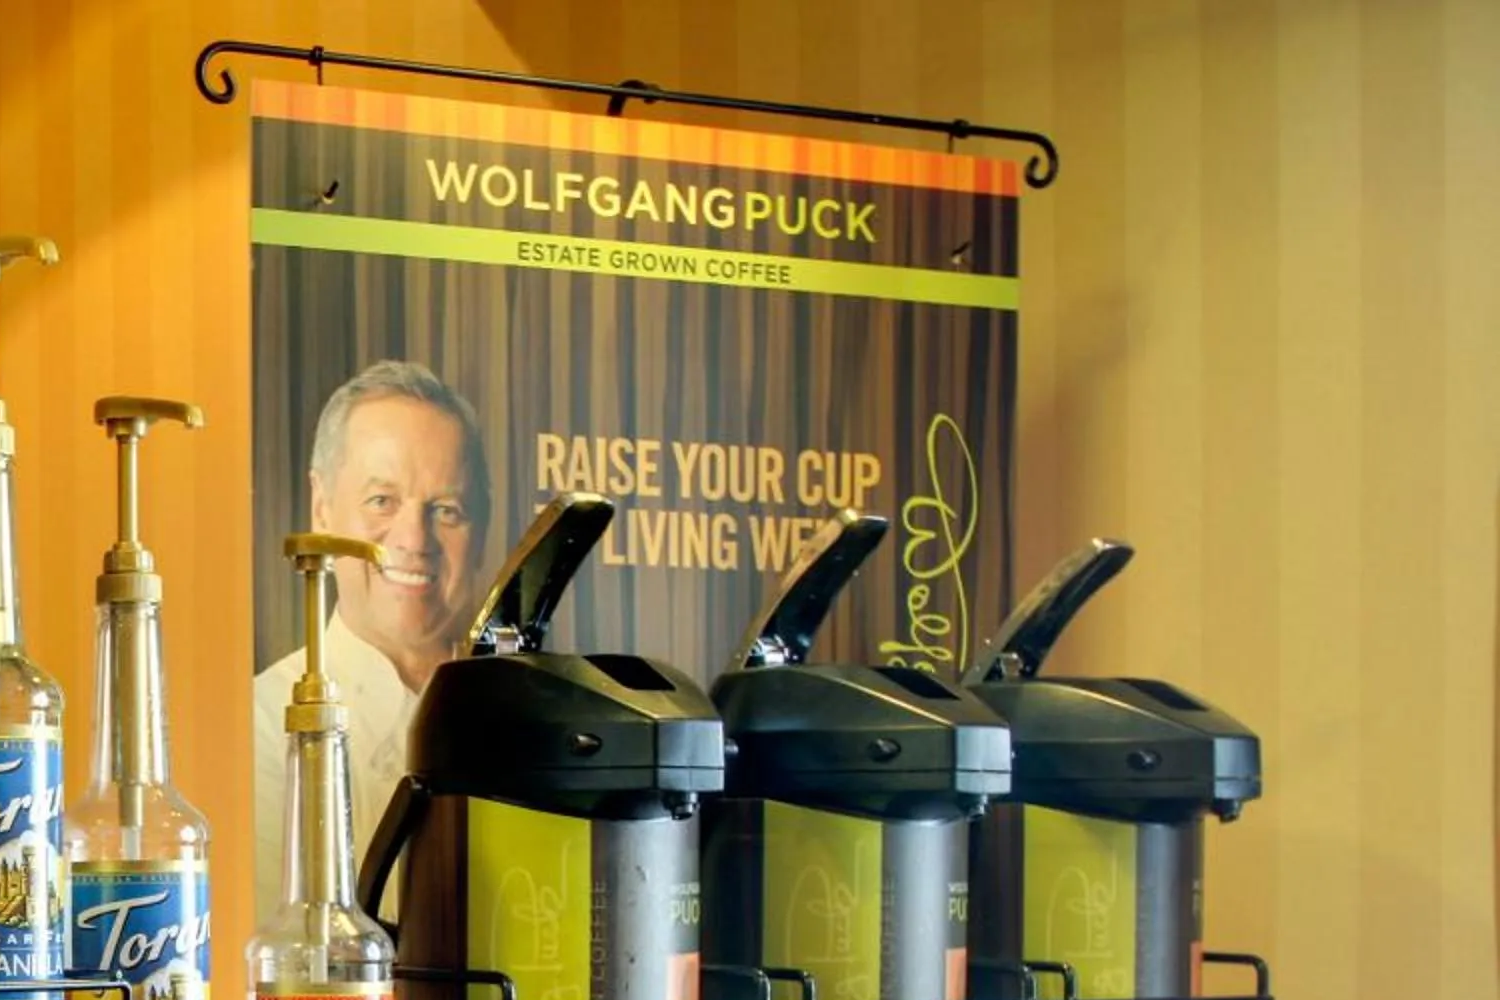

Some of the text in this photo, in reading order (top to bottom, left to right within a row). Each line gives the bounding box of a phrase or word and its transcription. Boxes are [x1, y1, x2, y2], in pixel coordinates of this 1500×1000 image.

[517, 241, 792, 285] ESTATE GROWN COFFEE
[536, 432, 882, 509] RAISE YOUR CUP
[602, 509, 833, 574] LIVING WE
